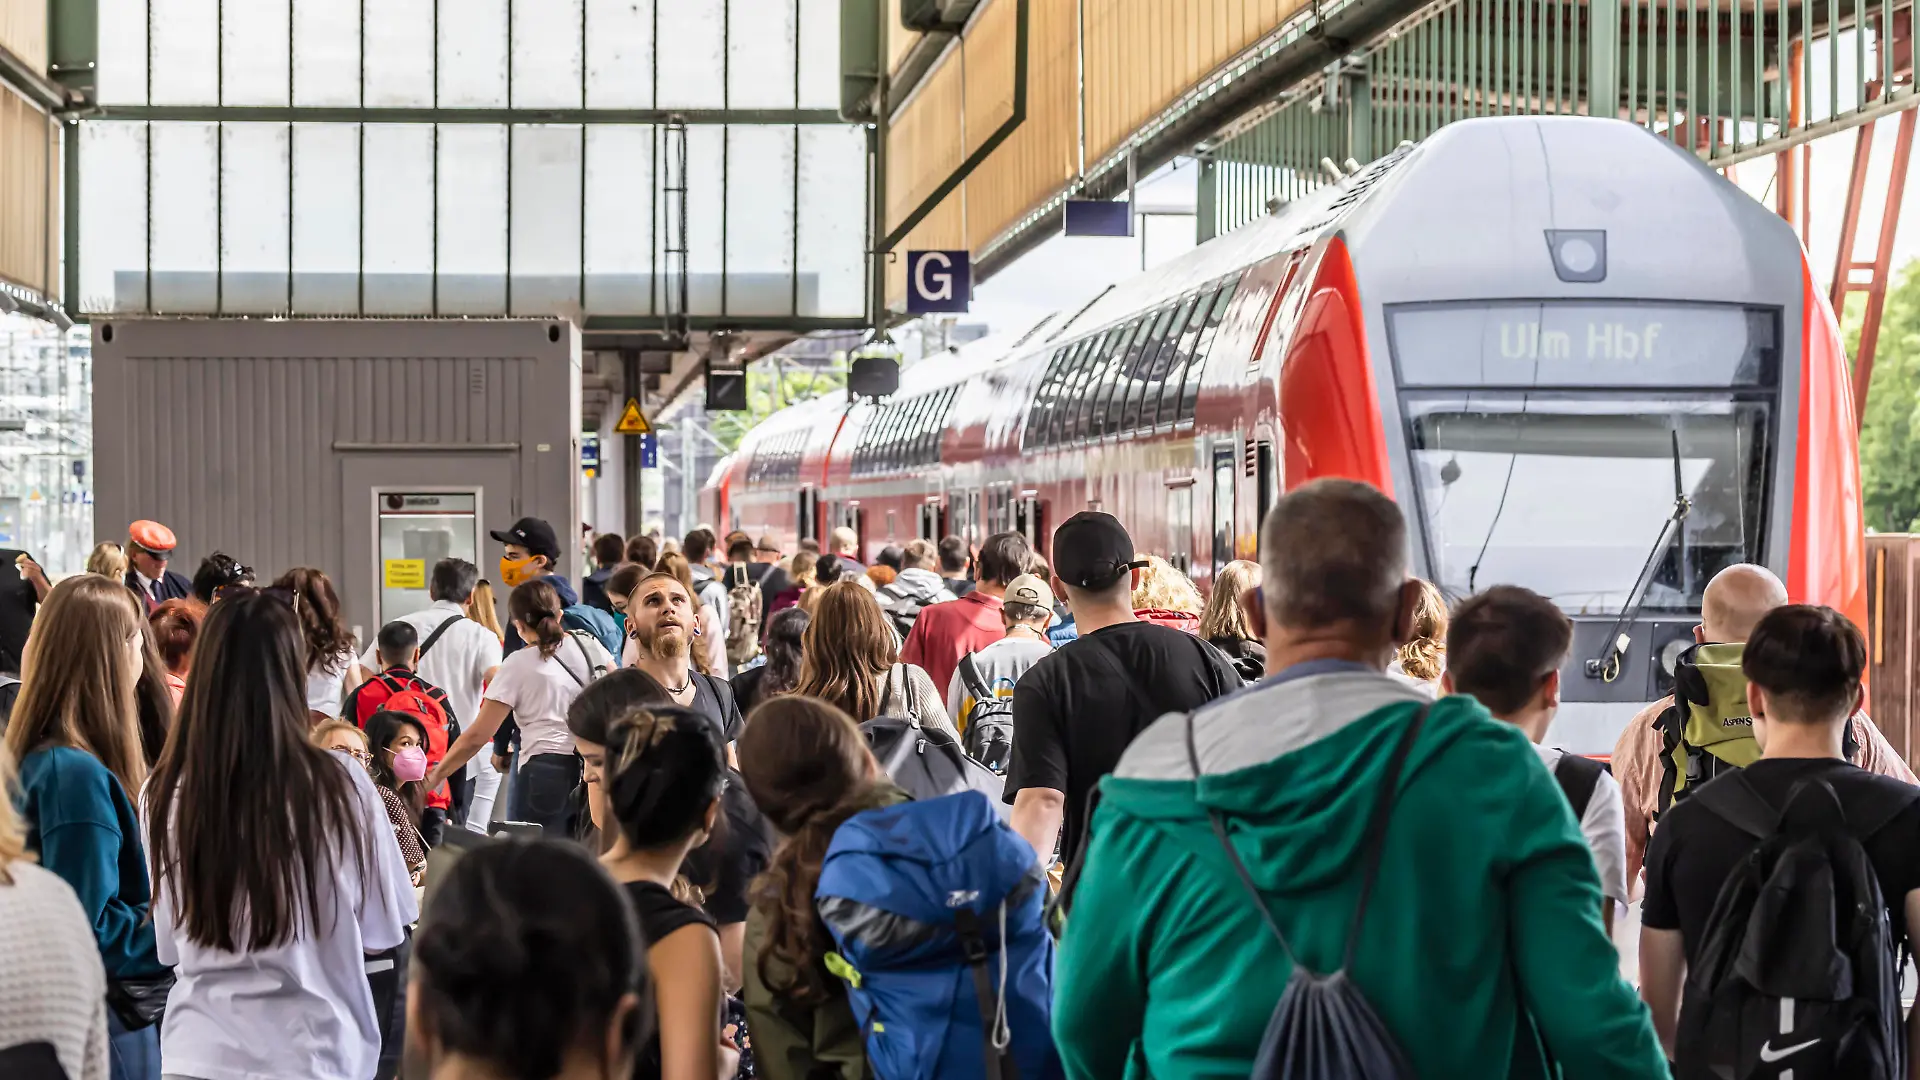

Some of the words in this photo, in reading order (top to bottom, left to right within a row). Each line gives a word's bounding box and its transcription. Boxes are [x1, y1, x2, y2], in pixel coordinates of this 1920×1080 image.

[914, 252, 952, 301] G
[1501, 322, 1570, 359] Ulm
[1587, 322, 1662, 360] Hbf
[1723, 716, 1753, 727] ASPENS
